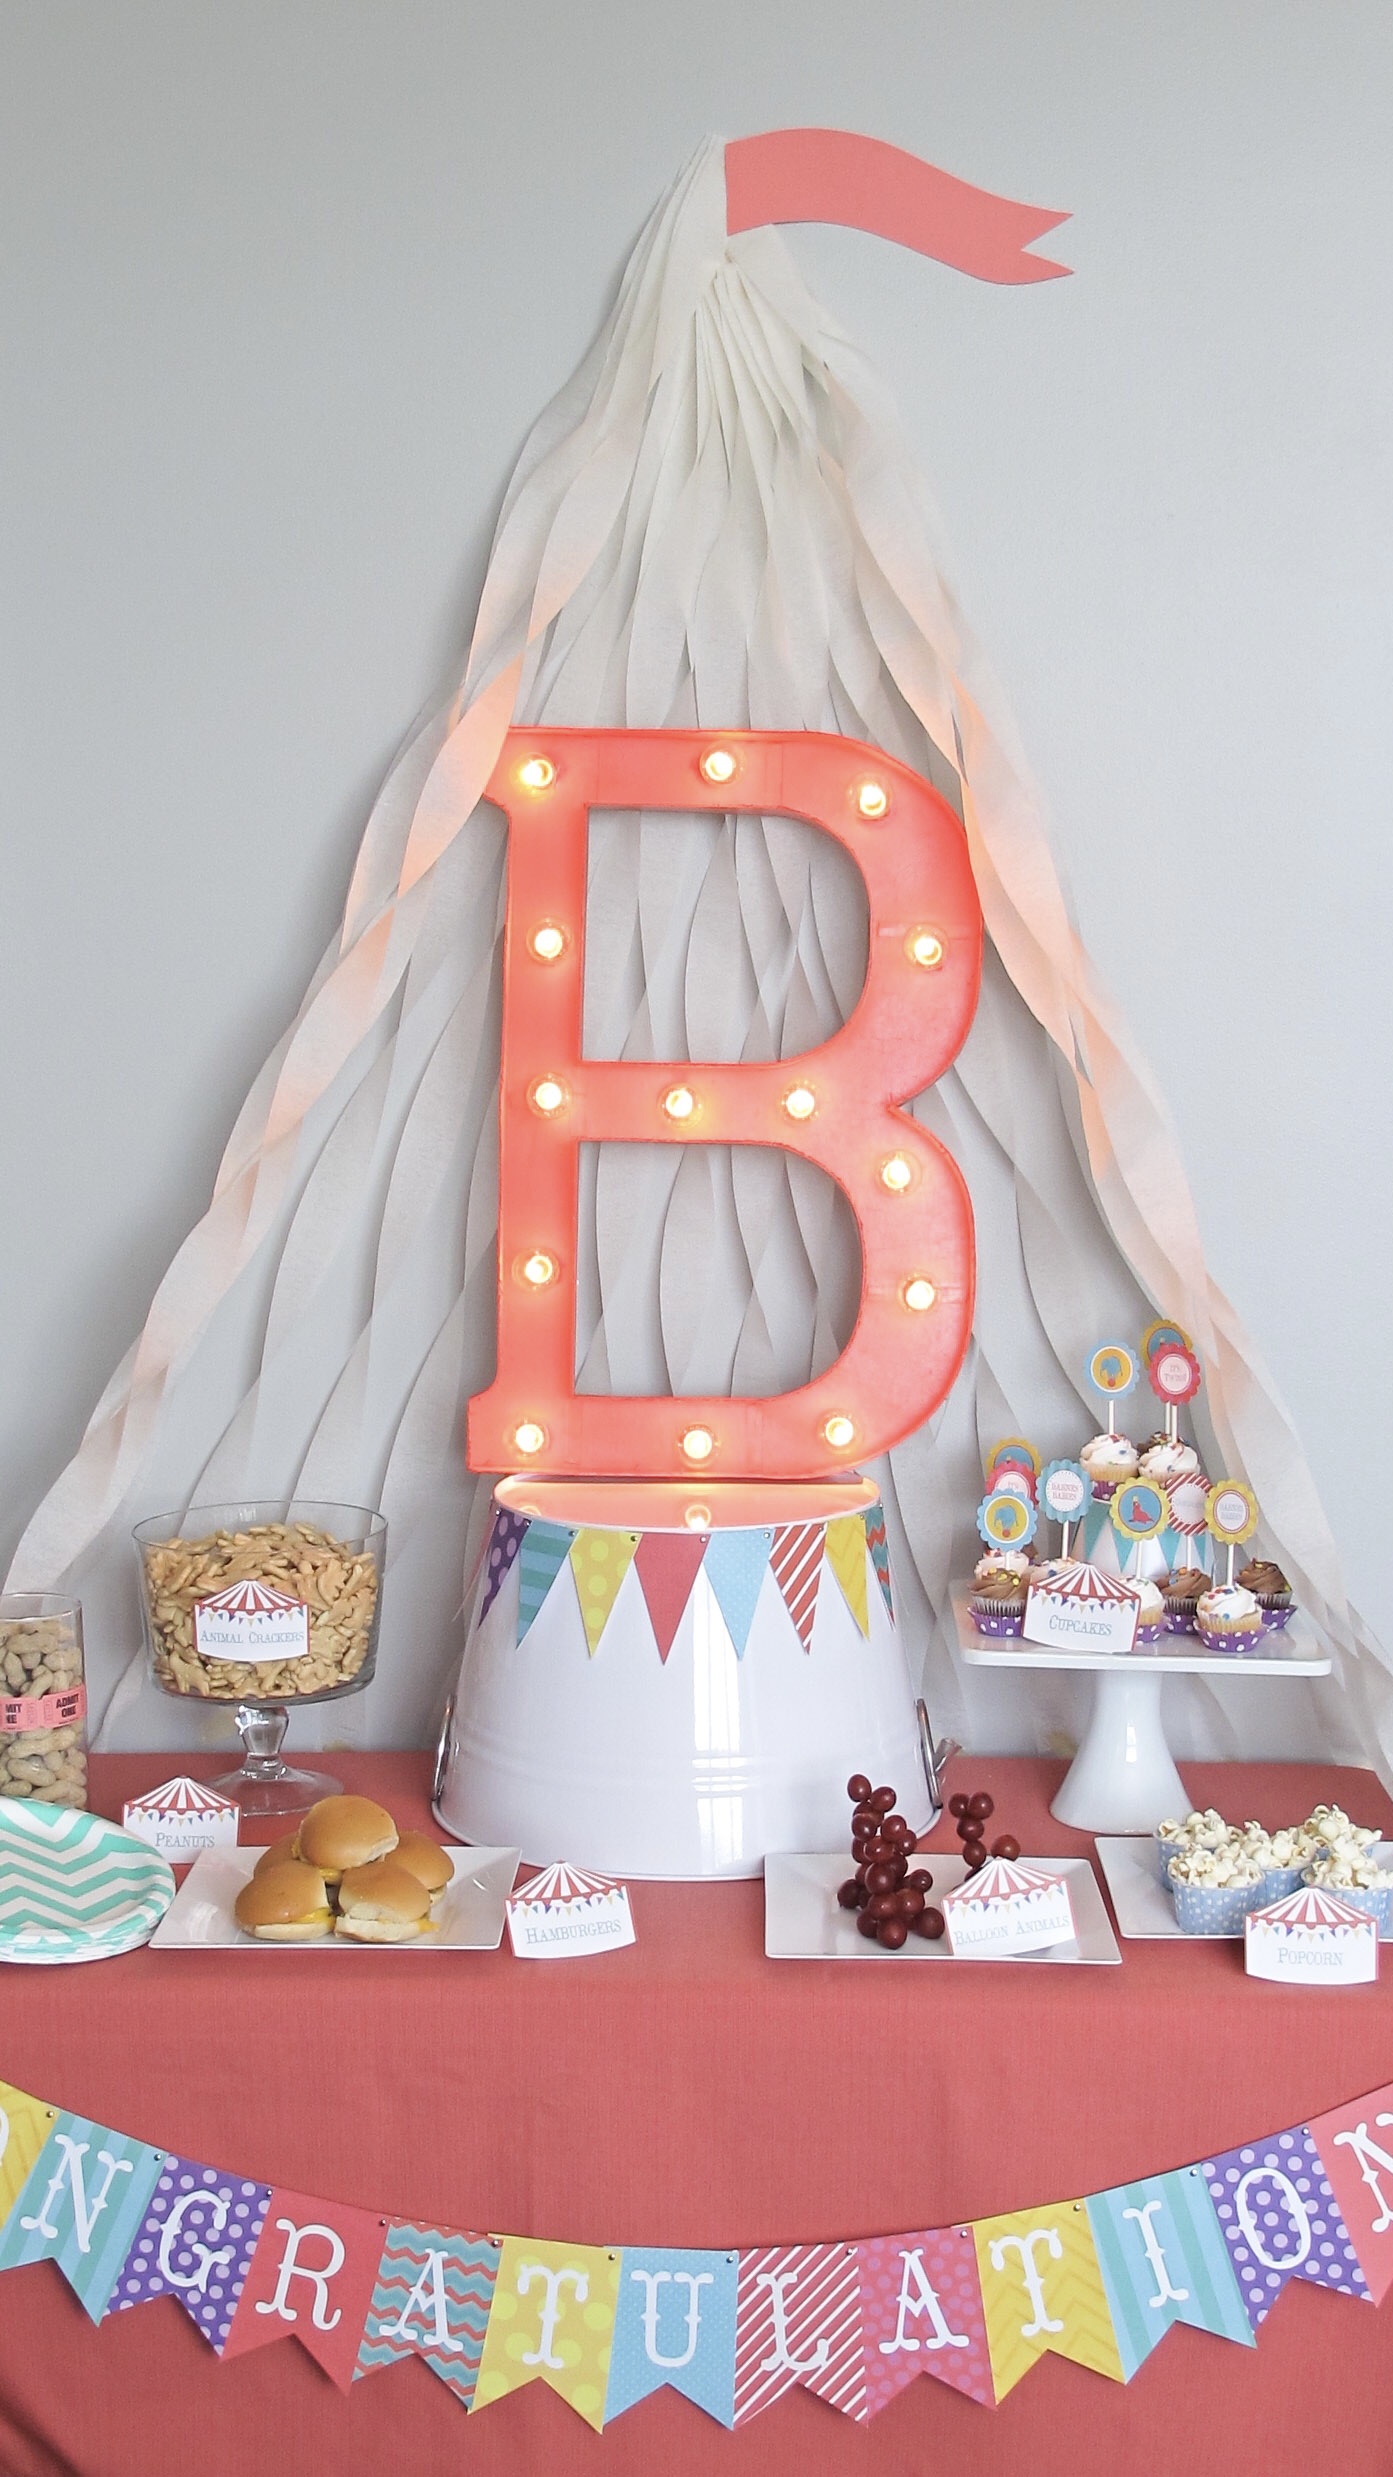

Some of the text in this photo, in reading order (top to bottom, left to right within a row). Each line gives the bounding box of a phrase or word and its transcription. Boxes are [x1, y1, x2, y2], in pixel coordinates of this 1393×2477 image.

[467, 727, 984, 1476] B
[1049, 1614, 1112, 1636] CUPCAKES
[200, 1629, 305, 1644] ANIMAL CRACKERS
[56, 1693, 79, 1709] ADMIT
[155, 1832, 215, 1848] PEANUTS
[525, 1919, 622, 1944] HAMBURGERS
[953, 1916, 1070, 1945] BALLOON ANIMALS
[1277, 1947, 1344, 1966] POPCORN
[0, 2106, 1393, 2372] NGRATULATION
